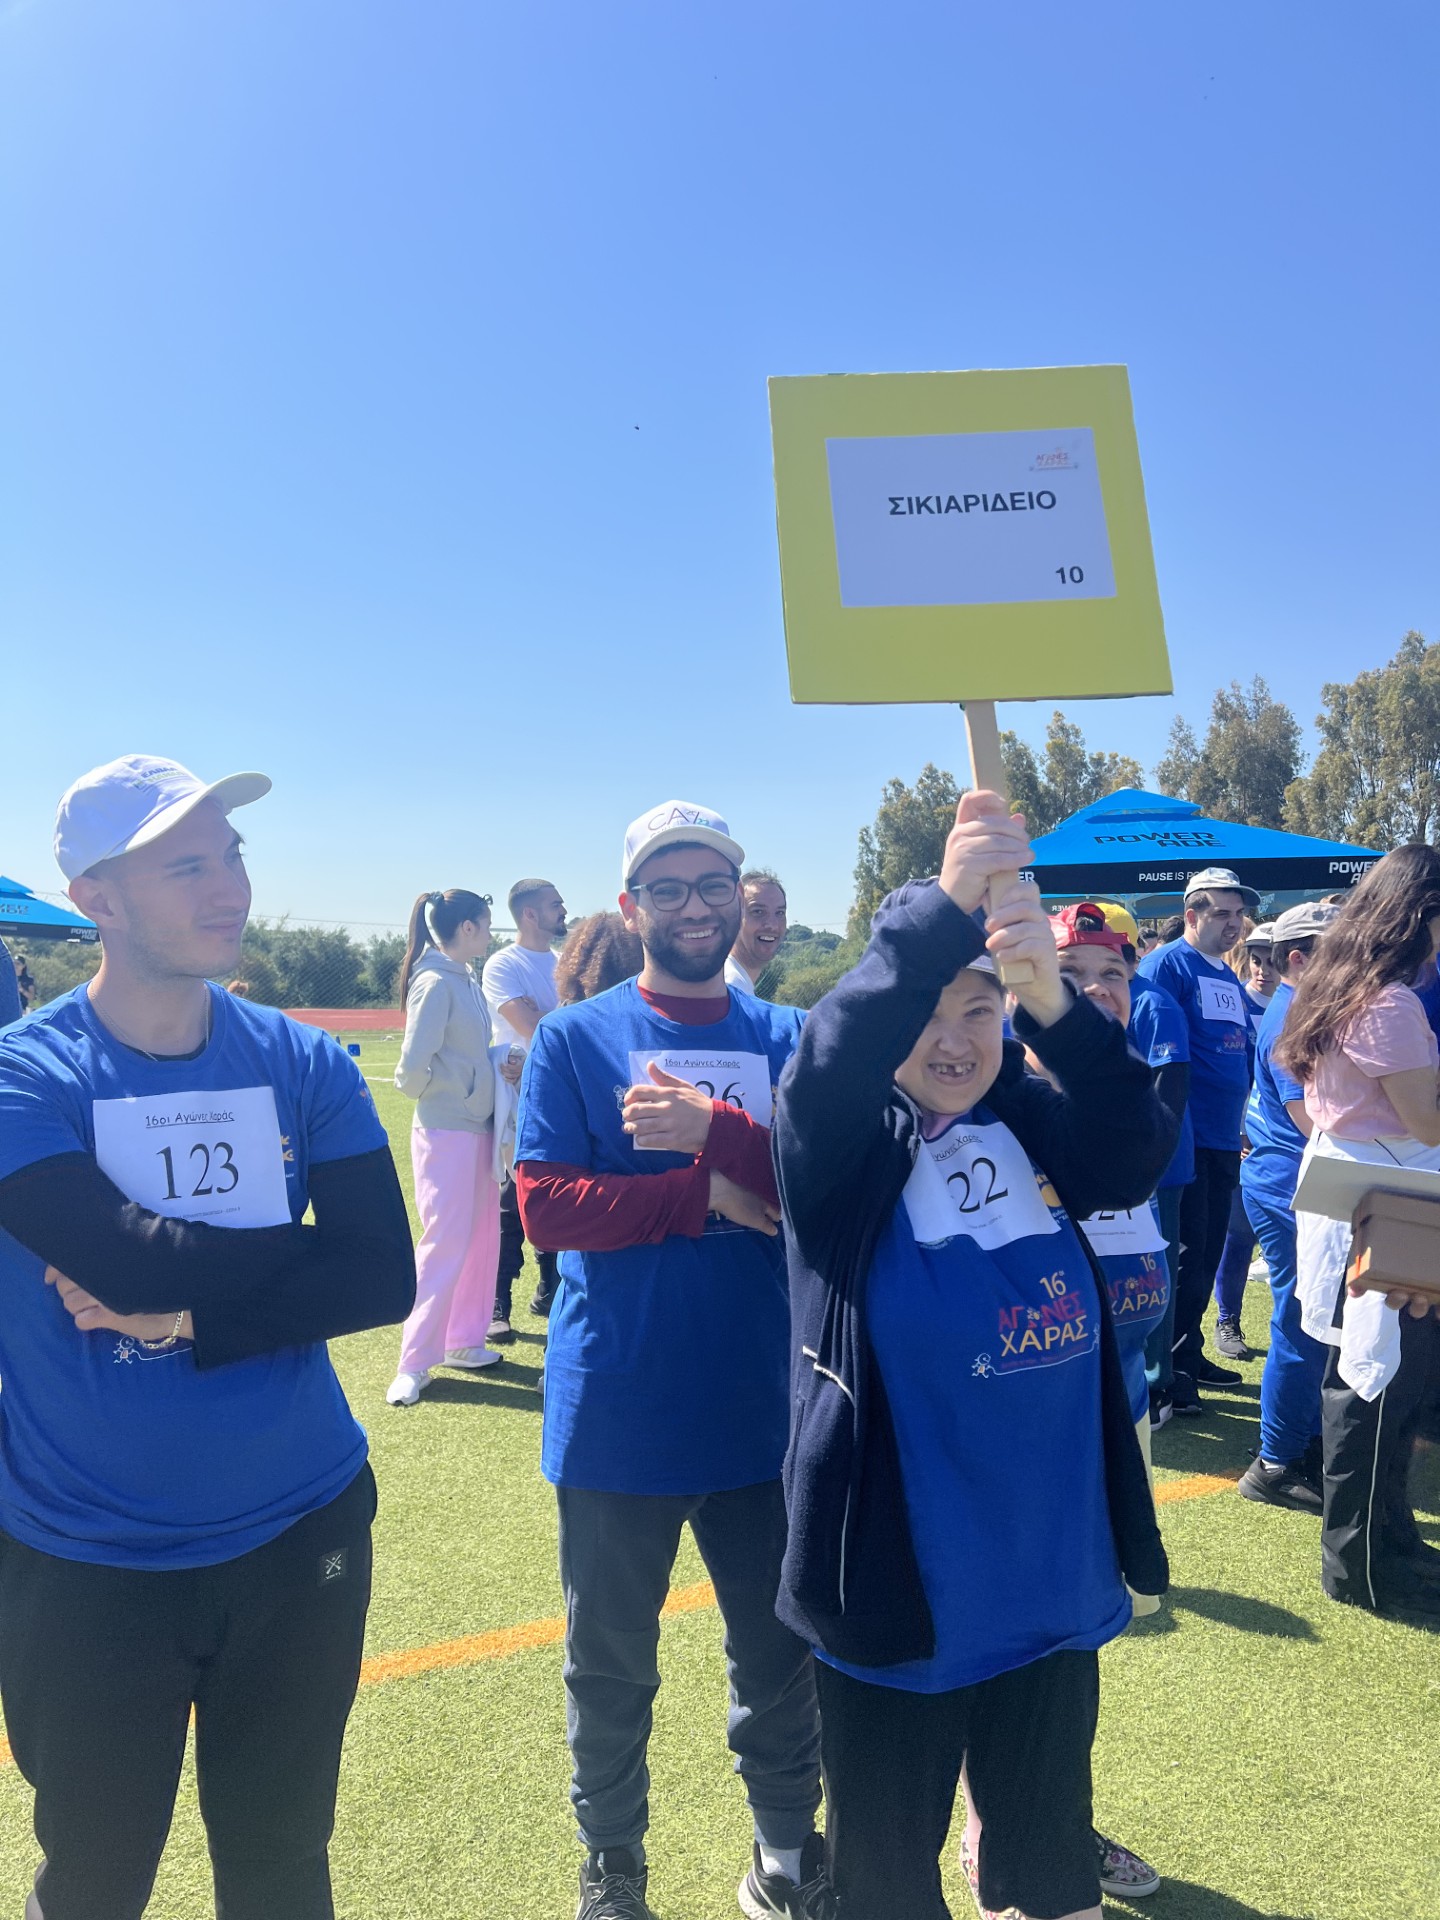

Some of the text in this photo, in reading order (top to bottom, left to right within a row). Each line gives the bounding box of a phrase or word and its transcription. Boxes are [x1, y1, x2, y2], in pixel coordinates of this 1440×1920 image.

[888, 490, 1057, 516] ΣΙΚΙΑΡΙΔΕΙΟ
[1056, 566, 1084, 584] 10
[1093, 832, 1216, 844] POWER
[1138, 872, 1173, 882] PAUSE
[1174, 871, 1184, 880] IS
[1328, 861, 1377, 874] POWE
[1214, 992, 1237, 1011] 193
[156, 1141, 239, 1200] 123
[946, 1157, 1008, 1213] 22
[1000, 1315, 1088, 1357] ΧΑΡΑΣ
